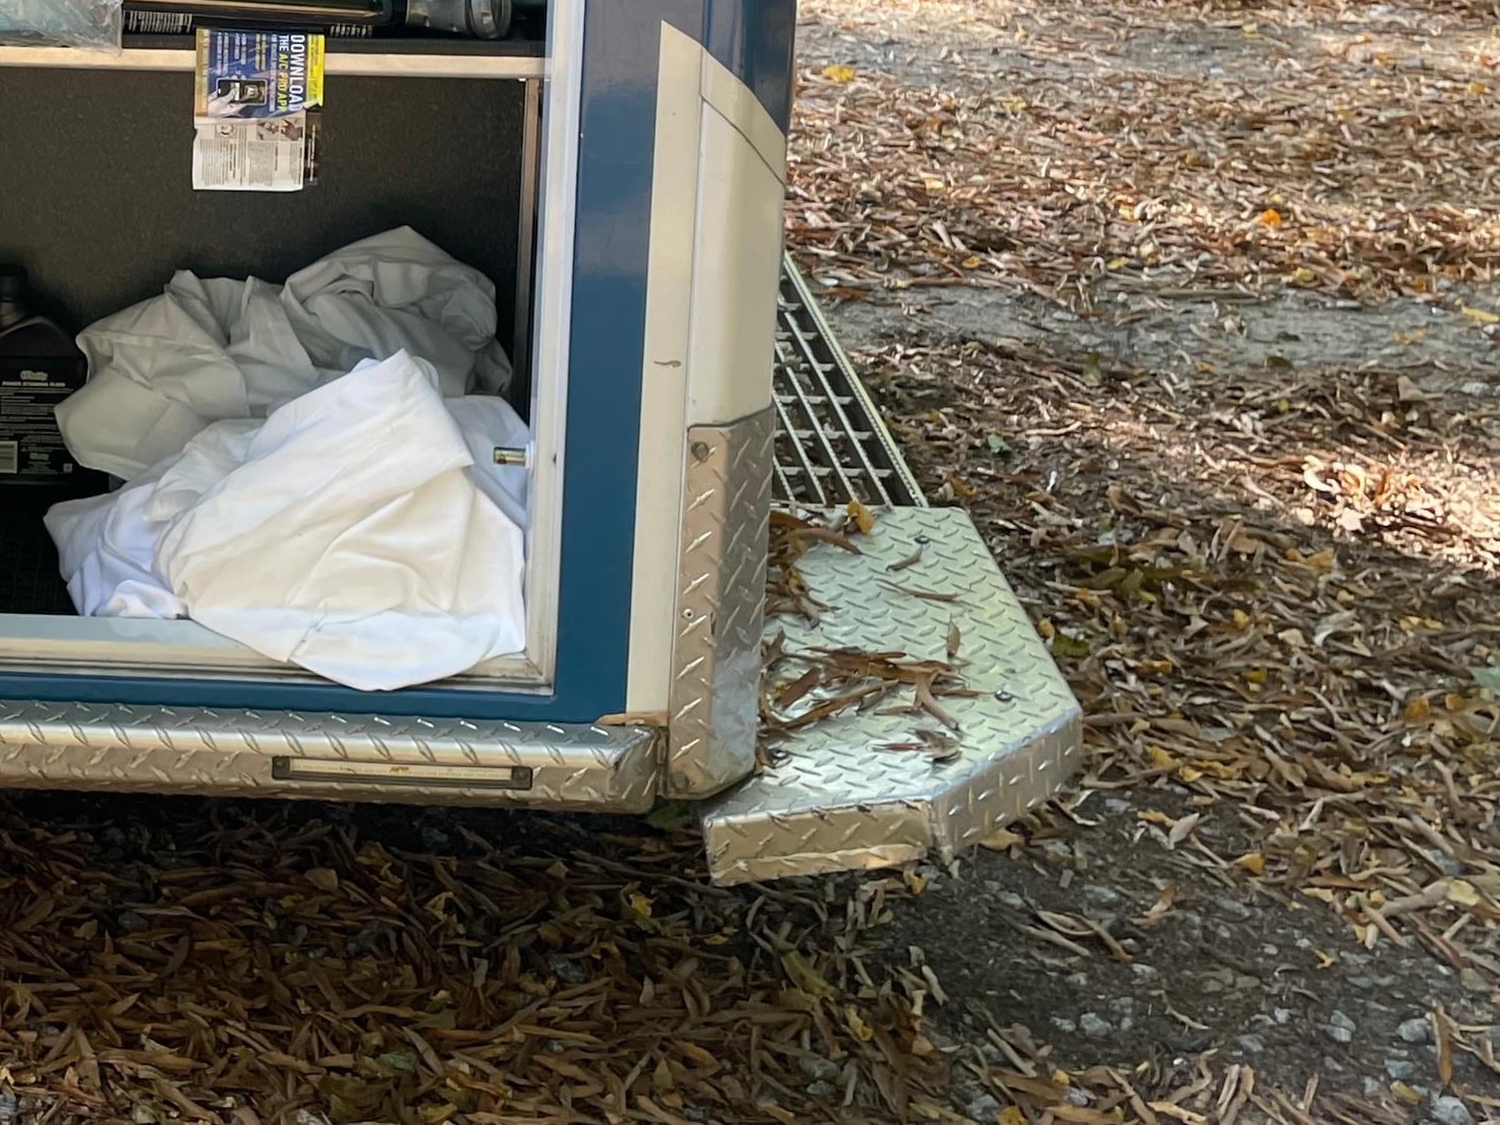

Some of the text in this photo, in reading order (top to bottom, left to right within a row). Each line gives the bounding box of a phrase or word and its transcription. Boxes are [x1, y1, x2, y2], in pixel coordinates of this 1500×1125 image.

[278, 34, 290, 52] THE
[278, 53, 289, 71] A/C
[277, 72, 289, 92] PRO
[288, 34, 306, 112] DOWNLOAD
